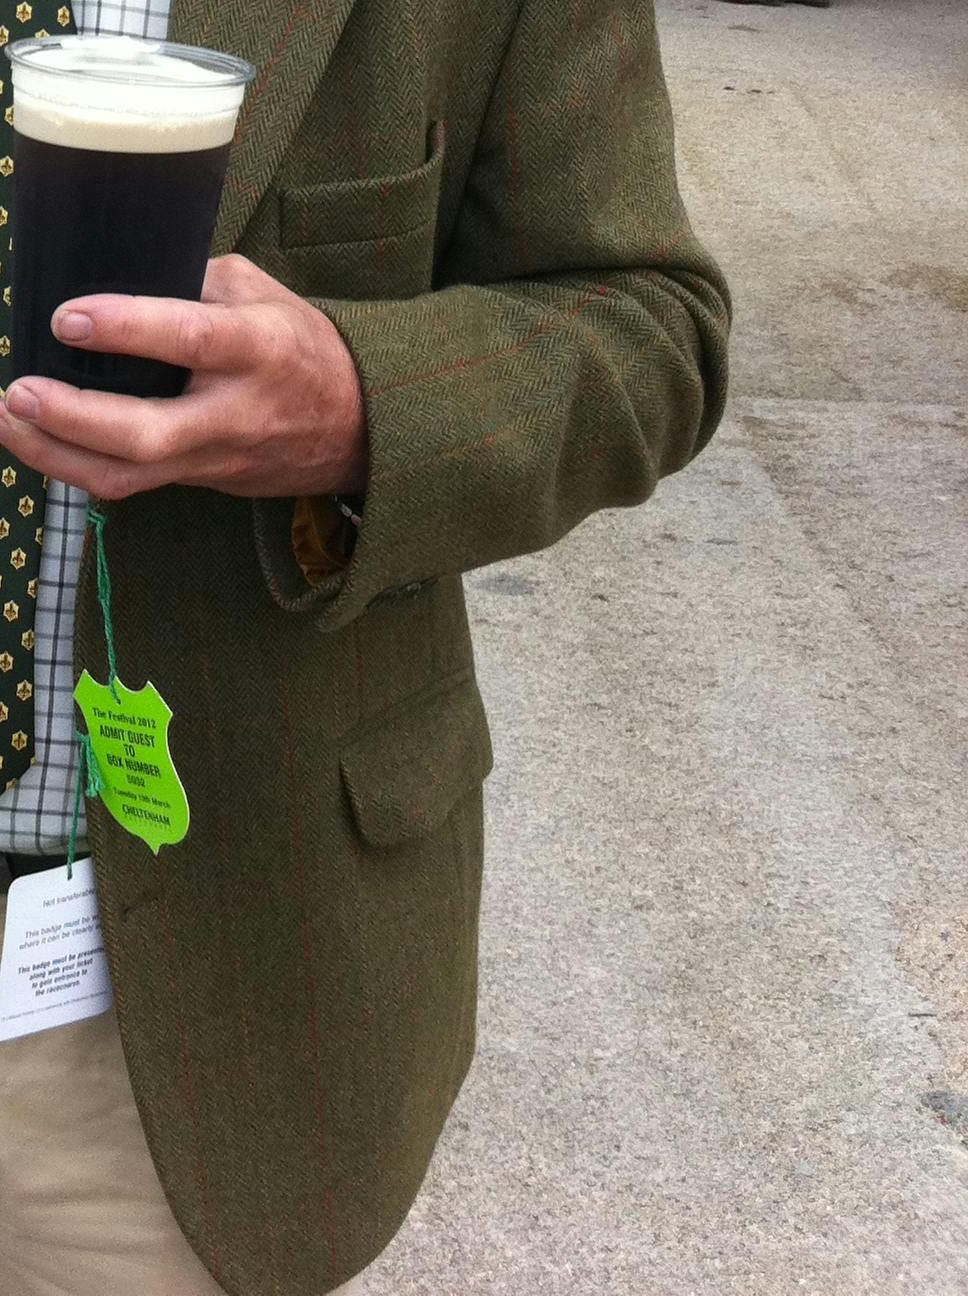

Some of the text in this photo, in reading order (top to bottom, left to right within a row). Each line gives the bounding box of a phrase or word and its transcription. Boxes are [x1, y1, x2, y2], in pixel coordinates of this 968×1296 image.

[92, 707, 156, 729] The Festival 2012
[99, 724, 155, 748] ADMIT GUEST
[123, 744, 136, 757] TO
[124, 757, 161, 778] NUMBER
[122, 804, 170, 825] CHELTENHAM
[25, 930, 39, 939] This
[41, 924, 62, 935] badge
[18, 966, 30, 975] This
[32, 961, 50, 970] badge
[52, 955, 67, 965] must
[68, 953, 76, 961] be
[29, 958, 93, 981] along with your ticket
[39, 978, 52, 988] gain
[54, 970, 80, 983] entrance
[35, 989, 45, 997] the
